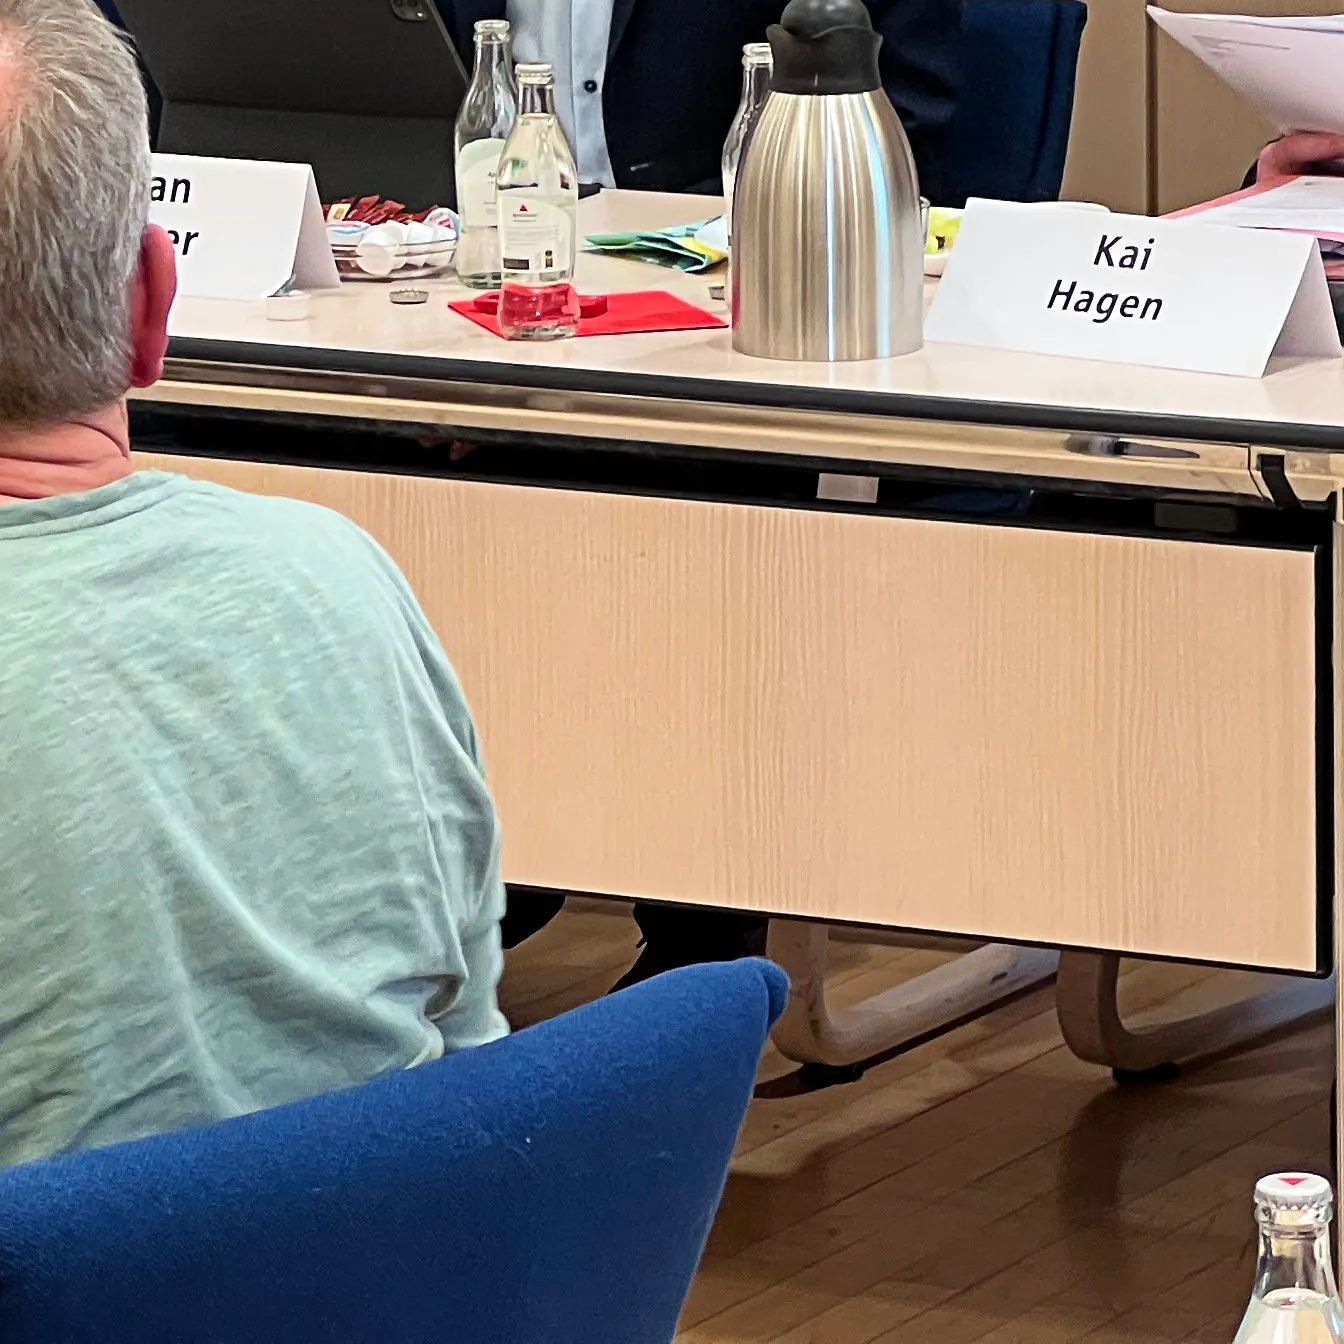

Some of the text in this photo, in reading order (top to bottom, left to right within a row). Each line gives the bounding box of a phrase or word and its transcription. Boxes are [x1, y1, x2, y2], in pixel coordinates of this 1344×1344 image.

[151, 176, 191, 204] an
[1093, 234, 1155, 271] Kai
[1047, 279, 1163, 324] Hagen
